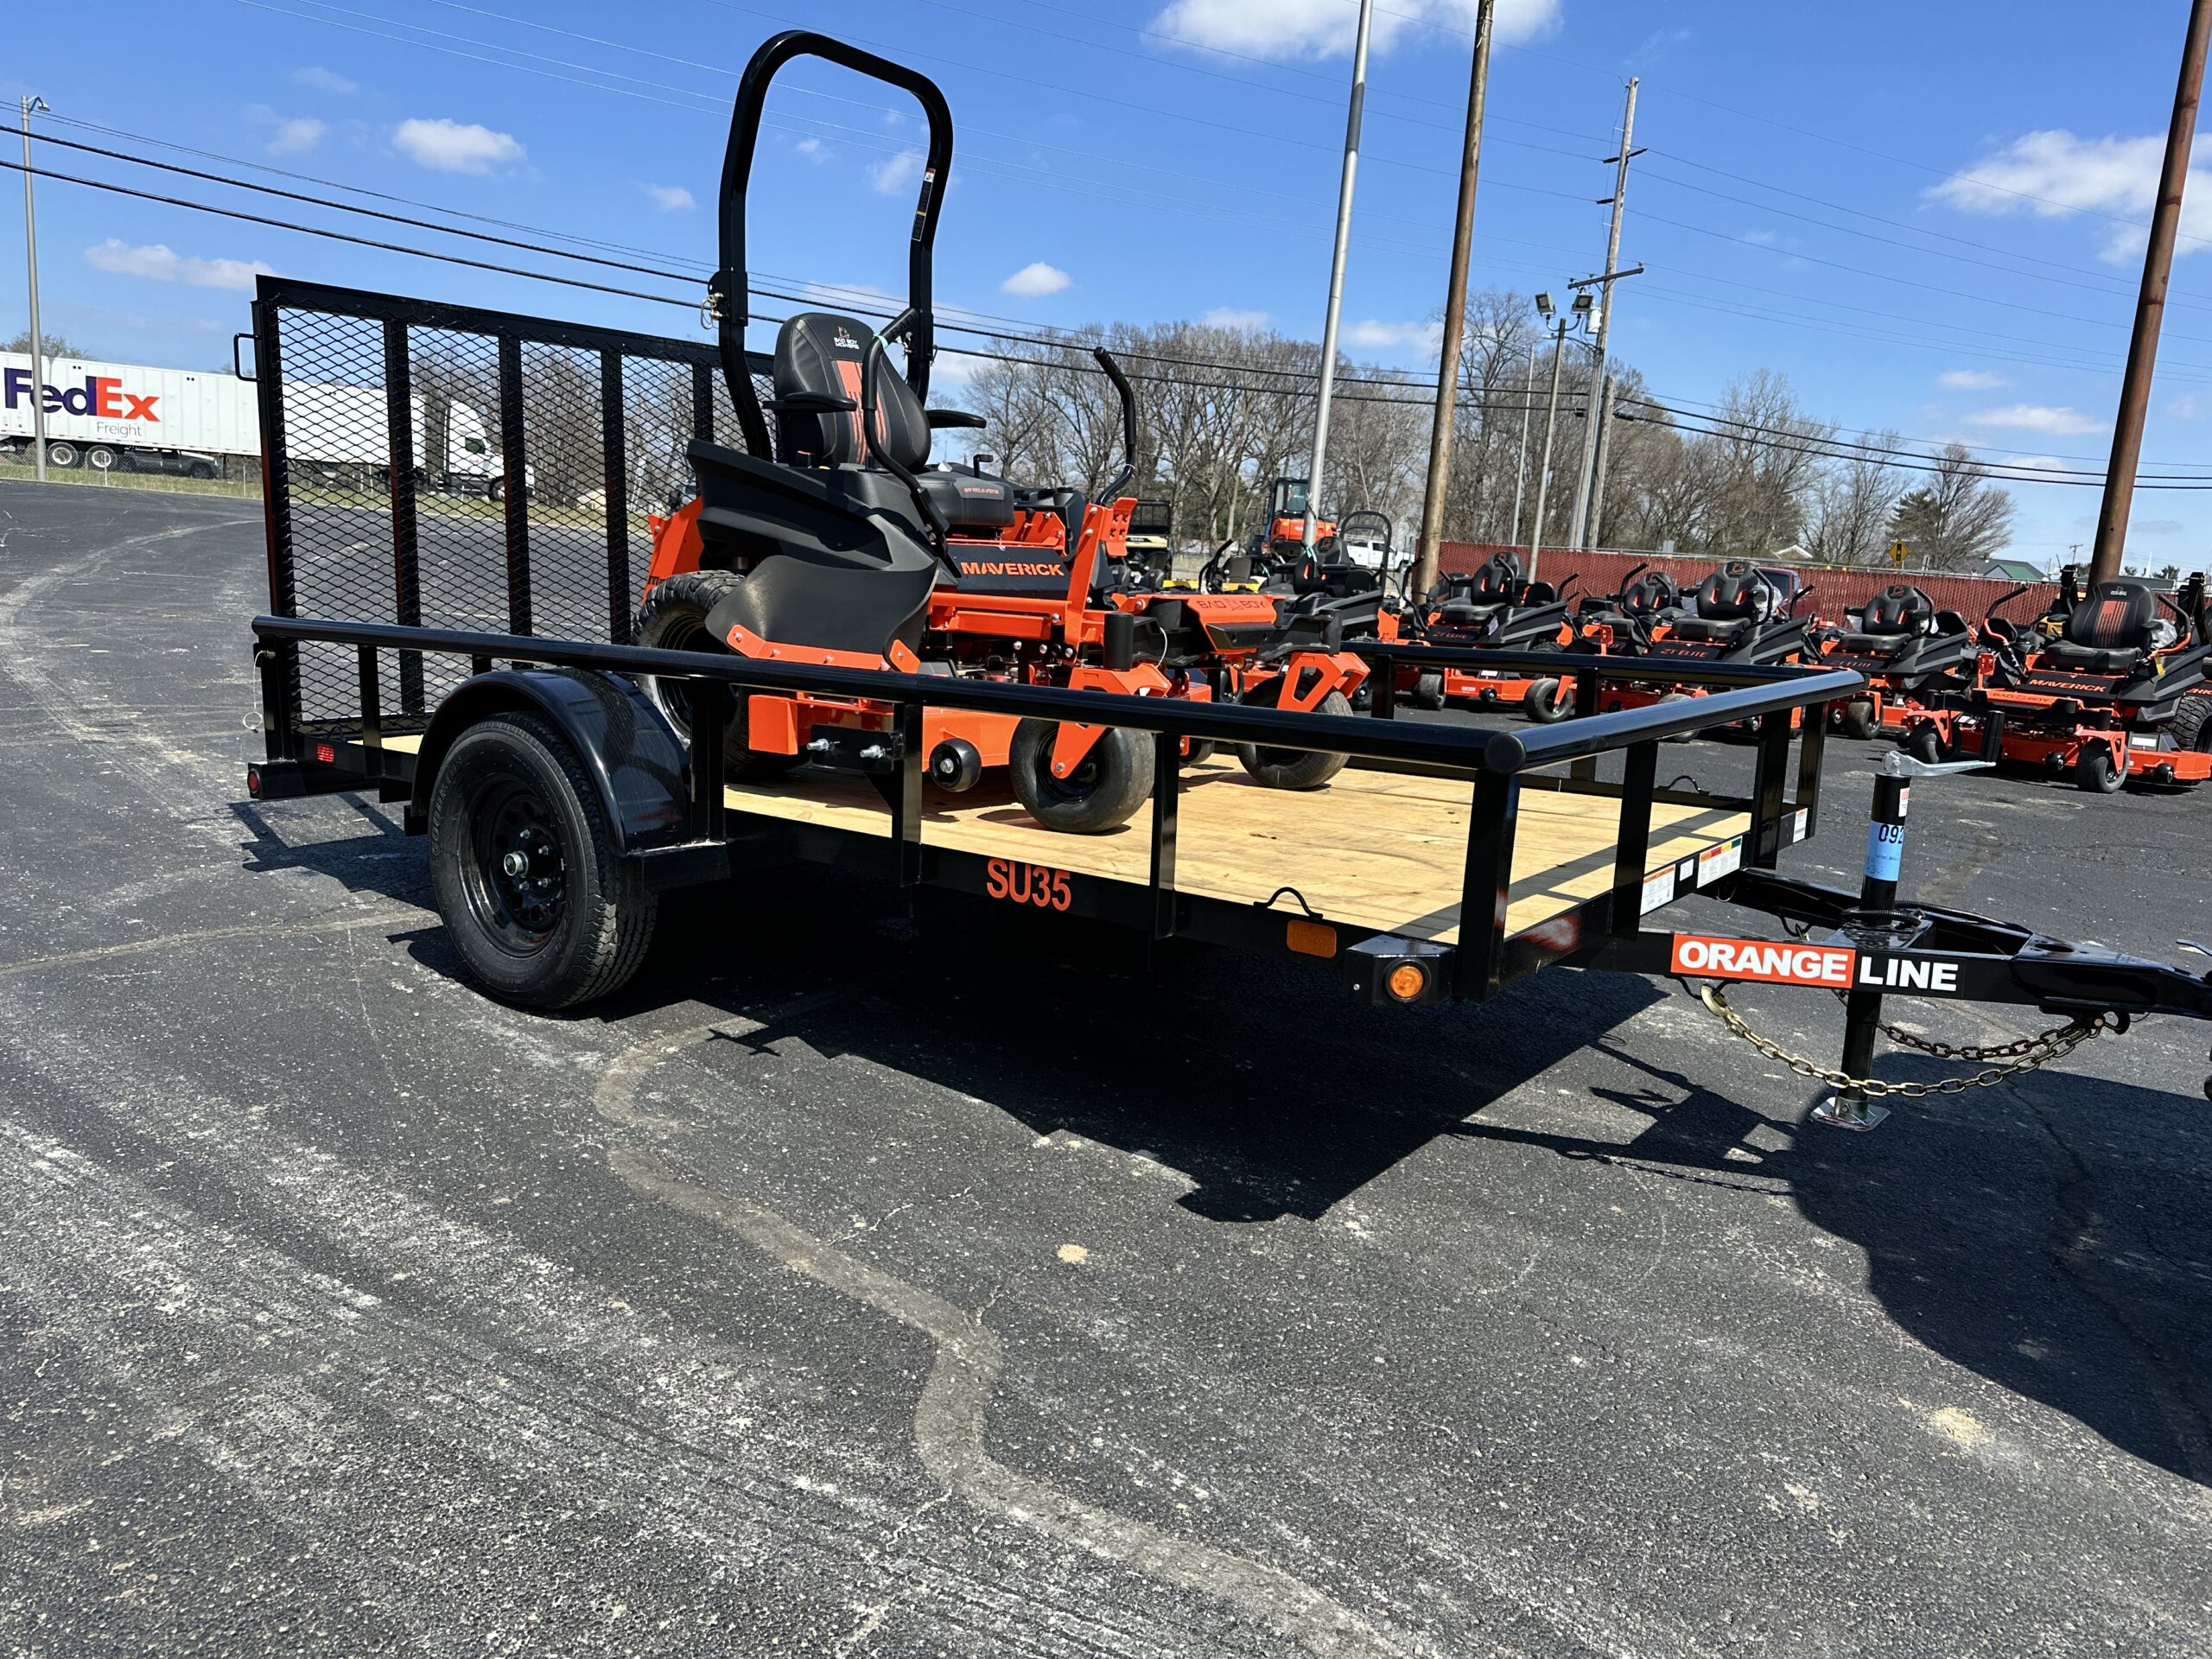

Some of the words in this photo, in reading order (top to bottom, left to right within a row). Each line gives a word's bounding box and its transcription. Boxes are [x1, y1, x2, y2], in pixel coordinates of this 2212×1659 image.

[3, 367, 161, 423] FedEx
[97, 422, 143, 438] Freight
[960, 562, 1065, 576] MAVERICK
[1197, 601, 1227, 609] BAD
[1240, 601, 1266, 609] BOY
[1678, 649, 1709, 658] ELITE
[2029, 679, 2107, 692] MAVERICK
[986, 857, 1071, 912] SU35
[1678, 940, 1848, 982] ORANGE
[1859, 956, 1958, 992] LINE
